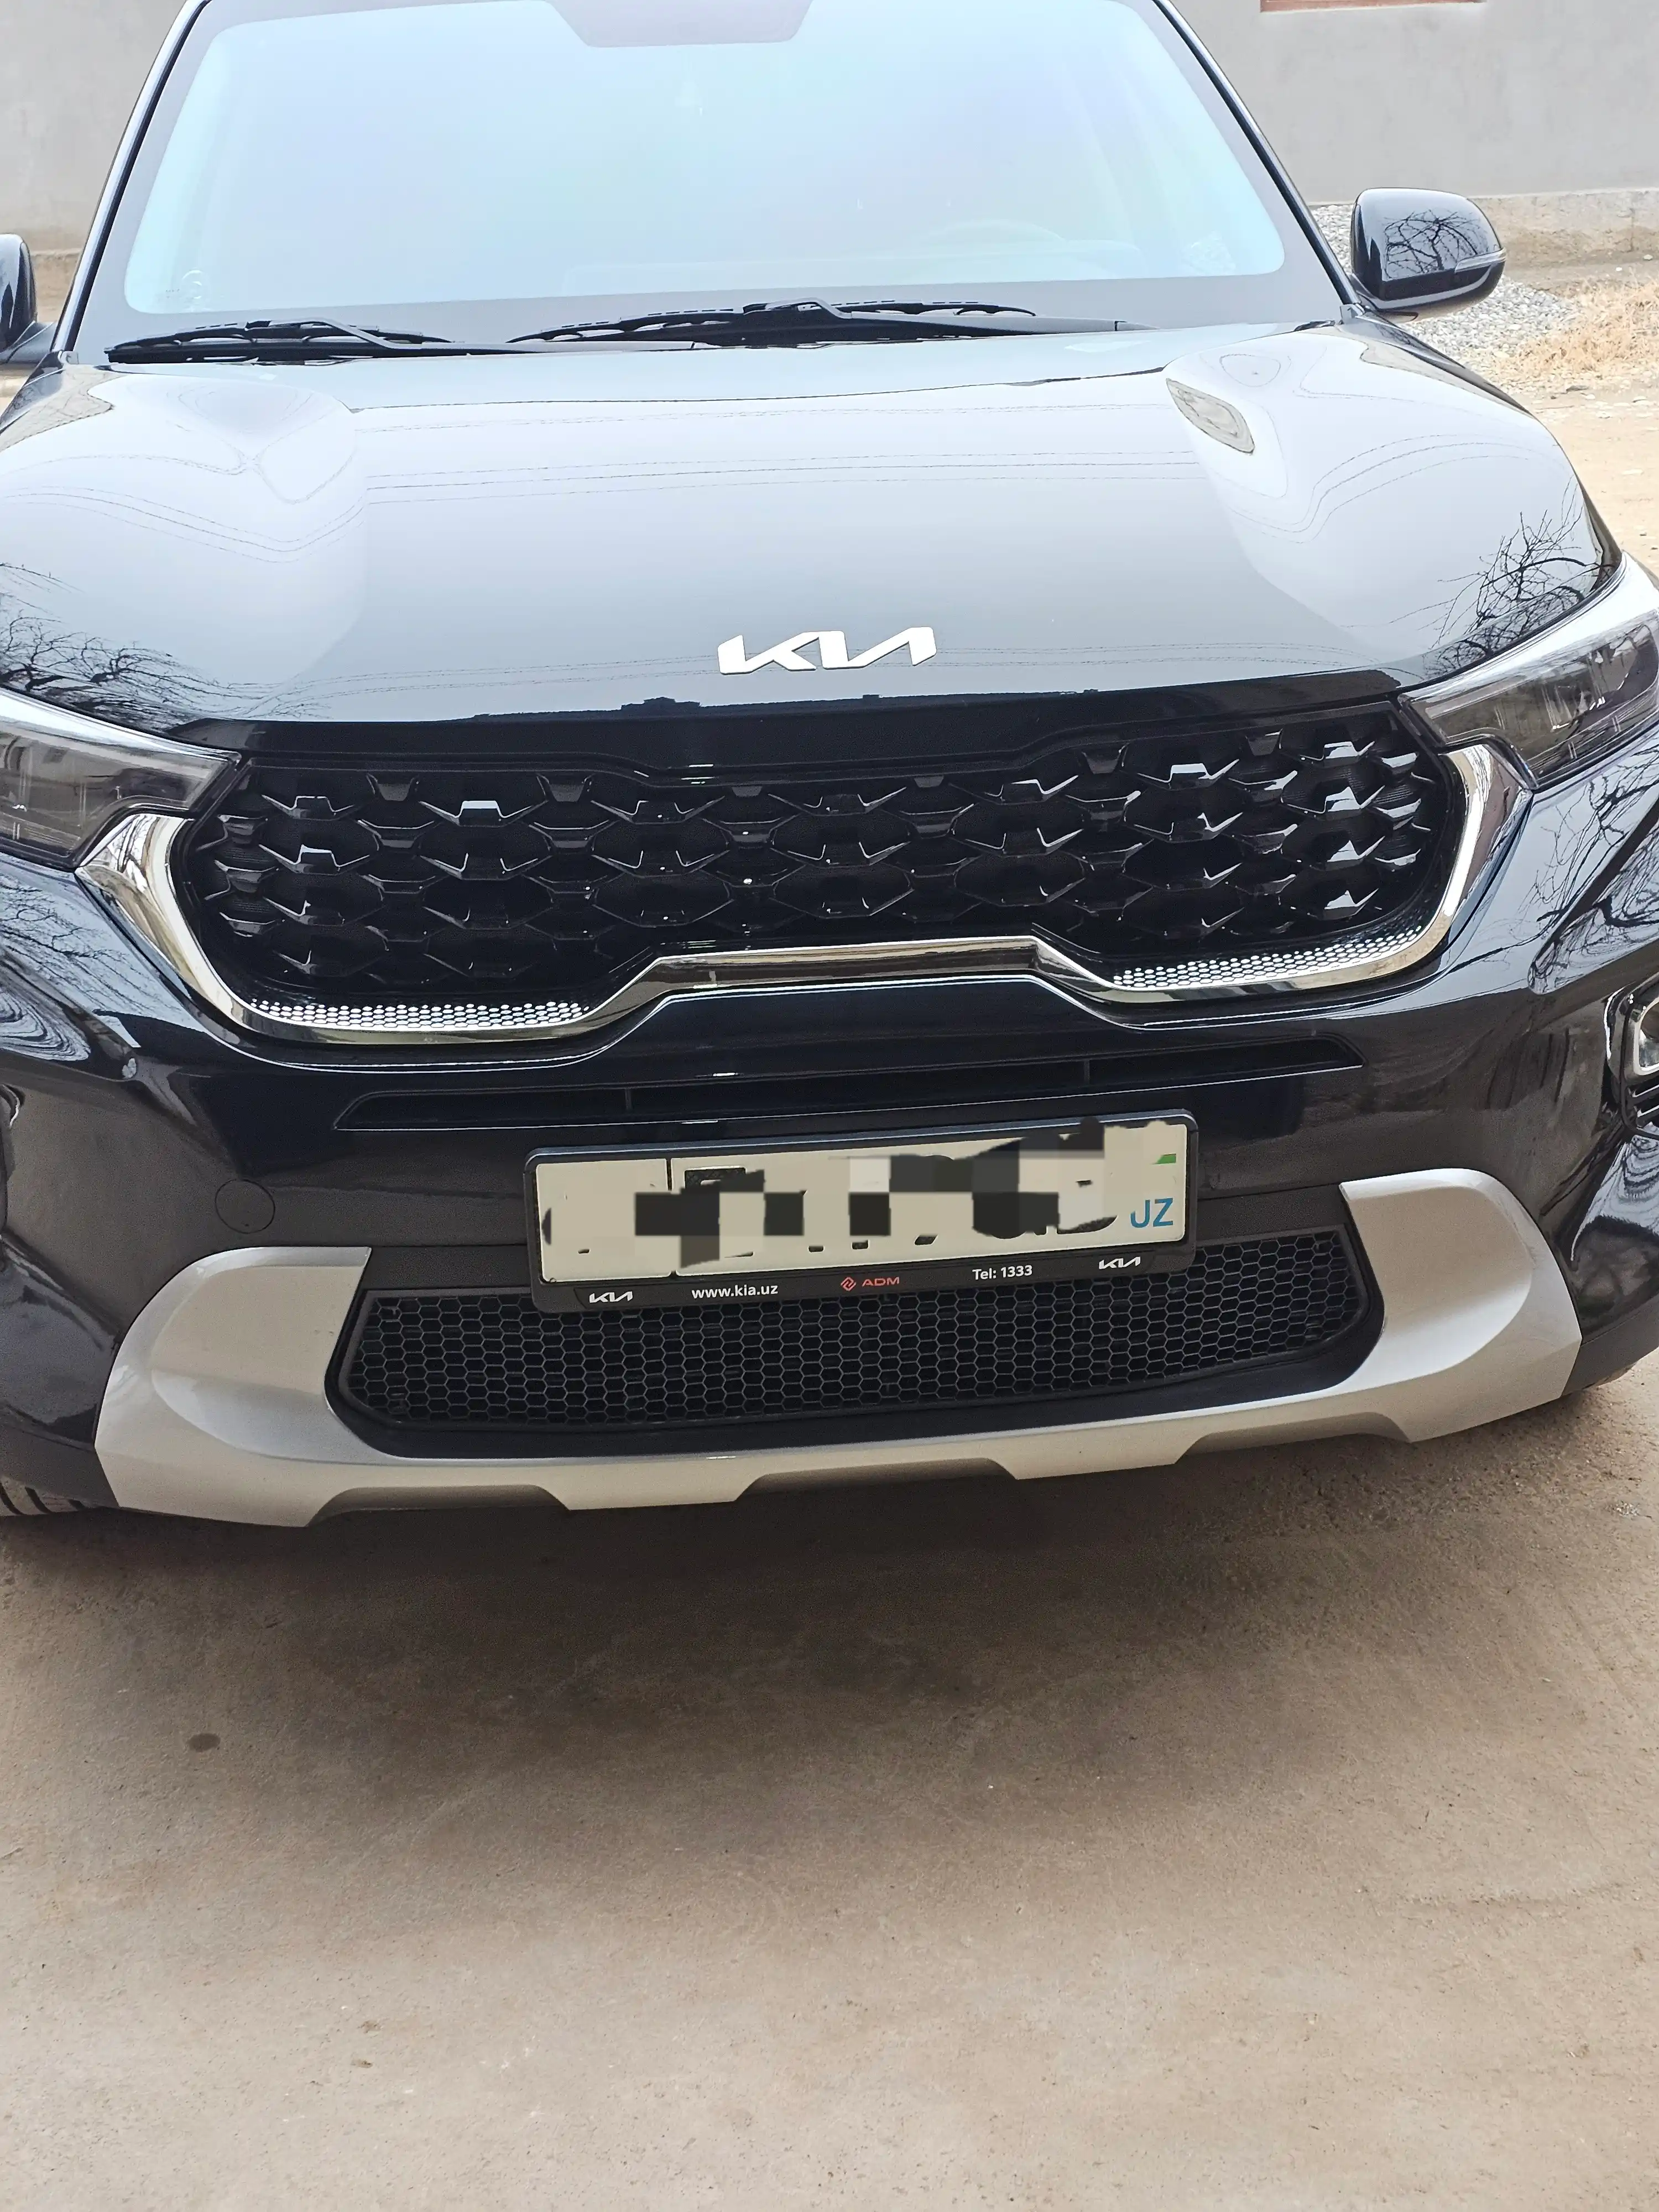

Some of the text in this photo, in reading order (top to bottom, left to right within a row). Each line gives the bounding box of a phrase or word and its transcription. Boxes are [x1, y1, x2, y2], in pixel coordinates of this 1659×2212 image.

[718, 627, 937, 675] KIA
[1098, 1256, 1141, 1270] KIA
[972, 1265, 1033, 1280] Tel: 1333
[862, 1277, 900, 1287] ADM
[589, 1291, 633, 1304] KIA
[691, 1284, 779, 1299] www.kia.uz
